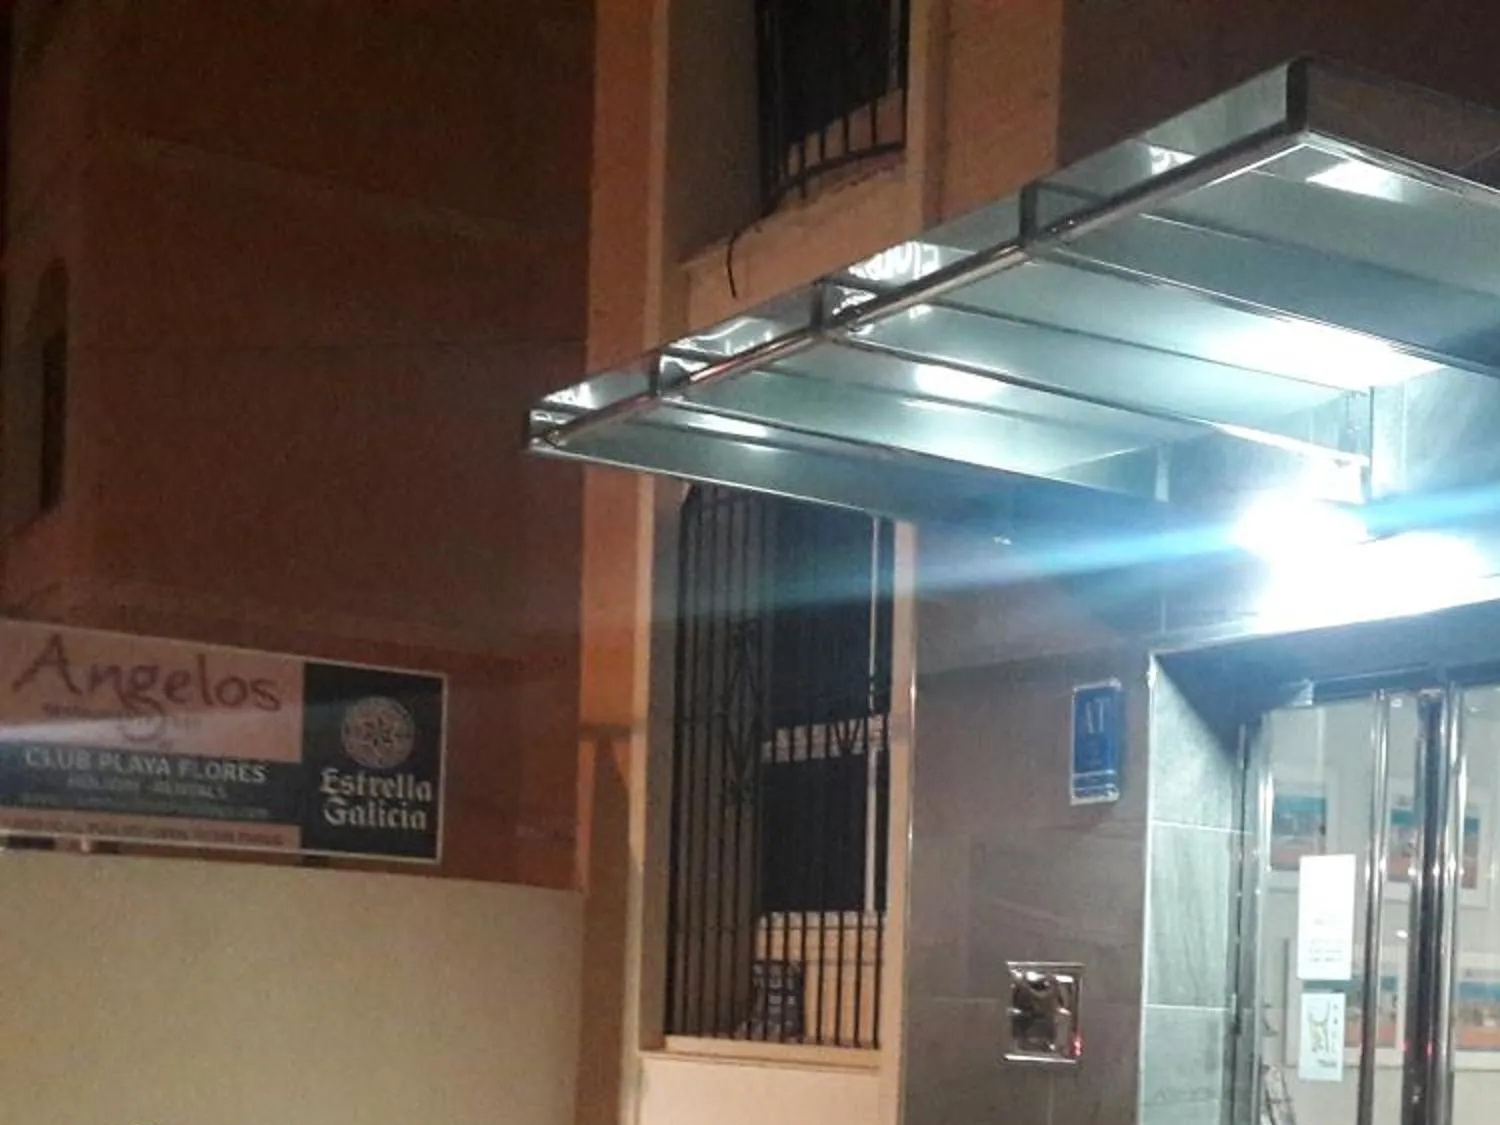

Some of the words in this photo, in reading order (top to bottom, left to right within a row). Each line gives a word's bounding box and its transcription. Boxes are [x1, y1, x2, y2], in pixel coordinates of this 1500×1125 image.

[12, 632, 281, 742] Angelos
[25, 745, 92, 771] CLUB
[98, 750, 171, 776] PLAYA
[178, 759, 268, 783] FLORES
[320, 766, 432, 803] Estrella
[323, 796, 427, 830] Galicia
